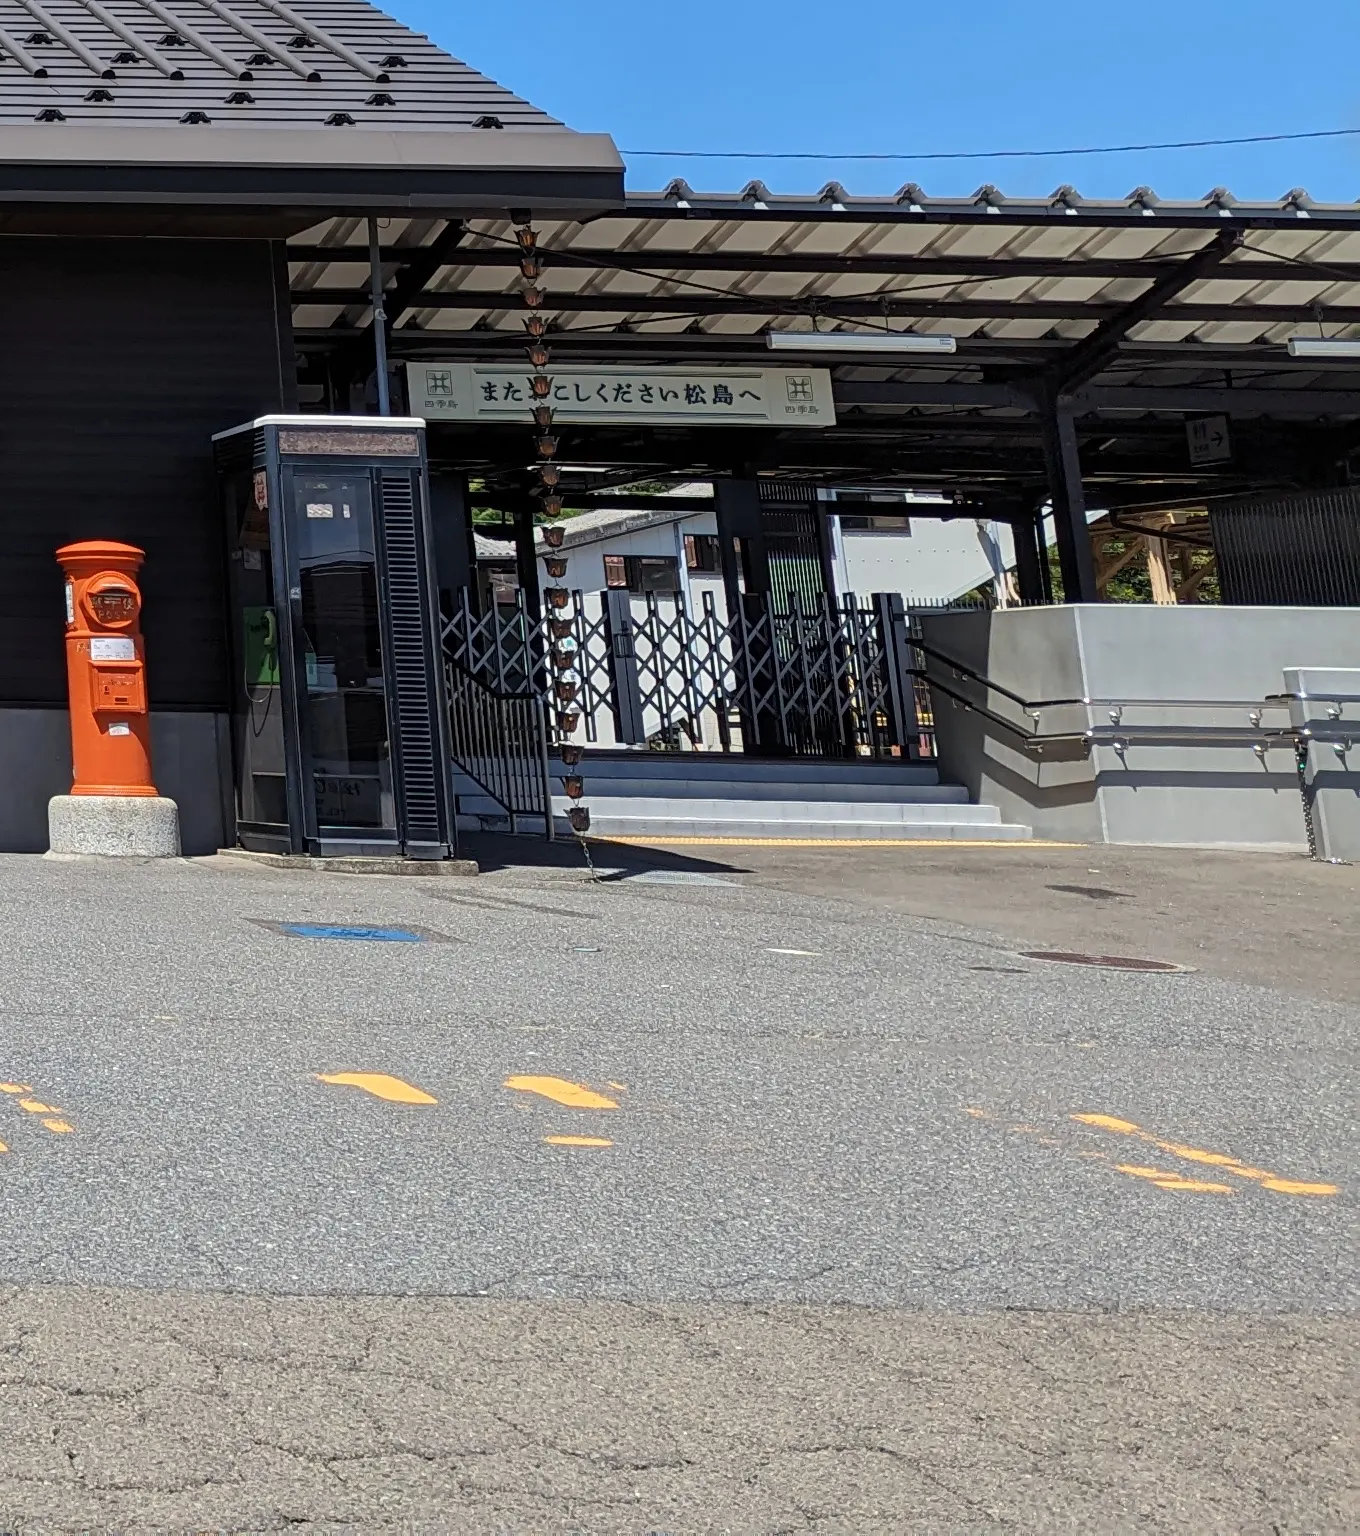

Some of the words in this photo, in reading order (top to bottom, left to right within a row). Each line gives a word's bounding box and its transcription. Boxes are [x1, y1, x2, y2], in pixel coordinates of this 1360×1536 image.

[480, 381, 761, 406] またこしください松島へ
